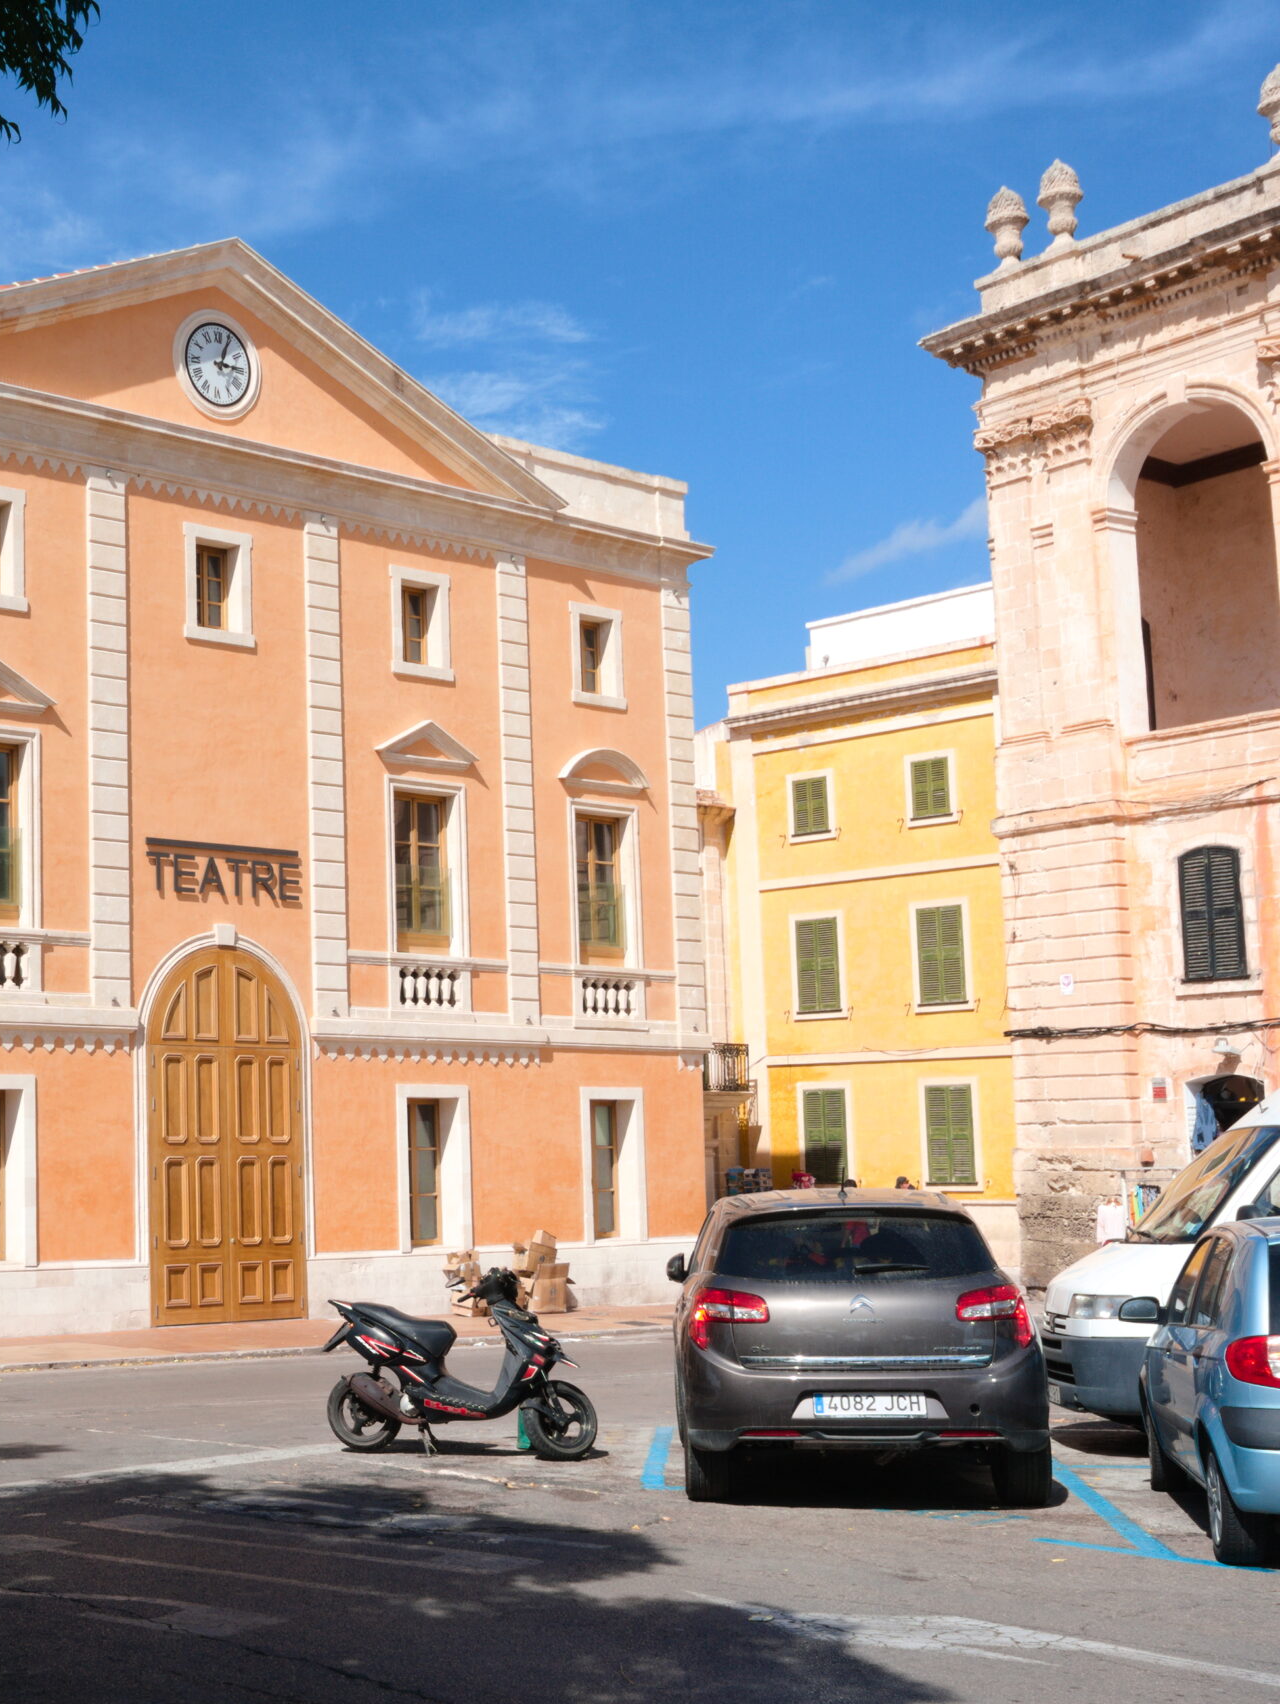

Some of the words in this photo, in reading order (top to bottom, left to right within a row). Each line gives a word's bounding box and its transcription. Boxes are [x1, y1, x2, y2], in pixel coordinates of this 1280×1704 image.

[146, 851, 301, 902] TEATRE
[828, 1394, 877, 1412] 4082
[885, 1394, 921, 1412] JCH
